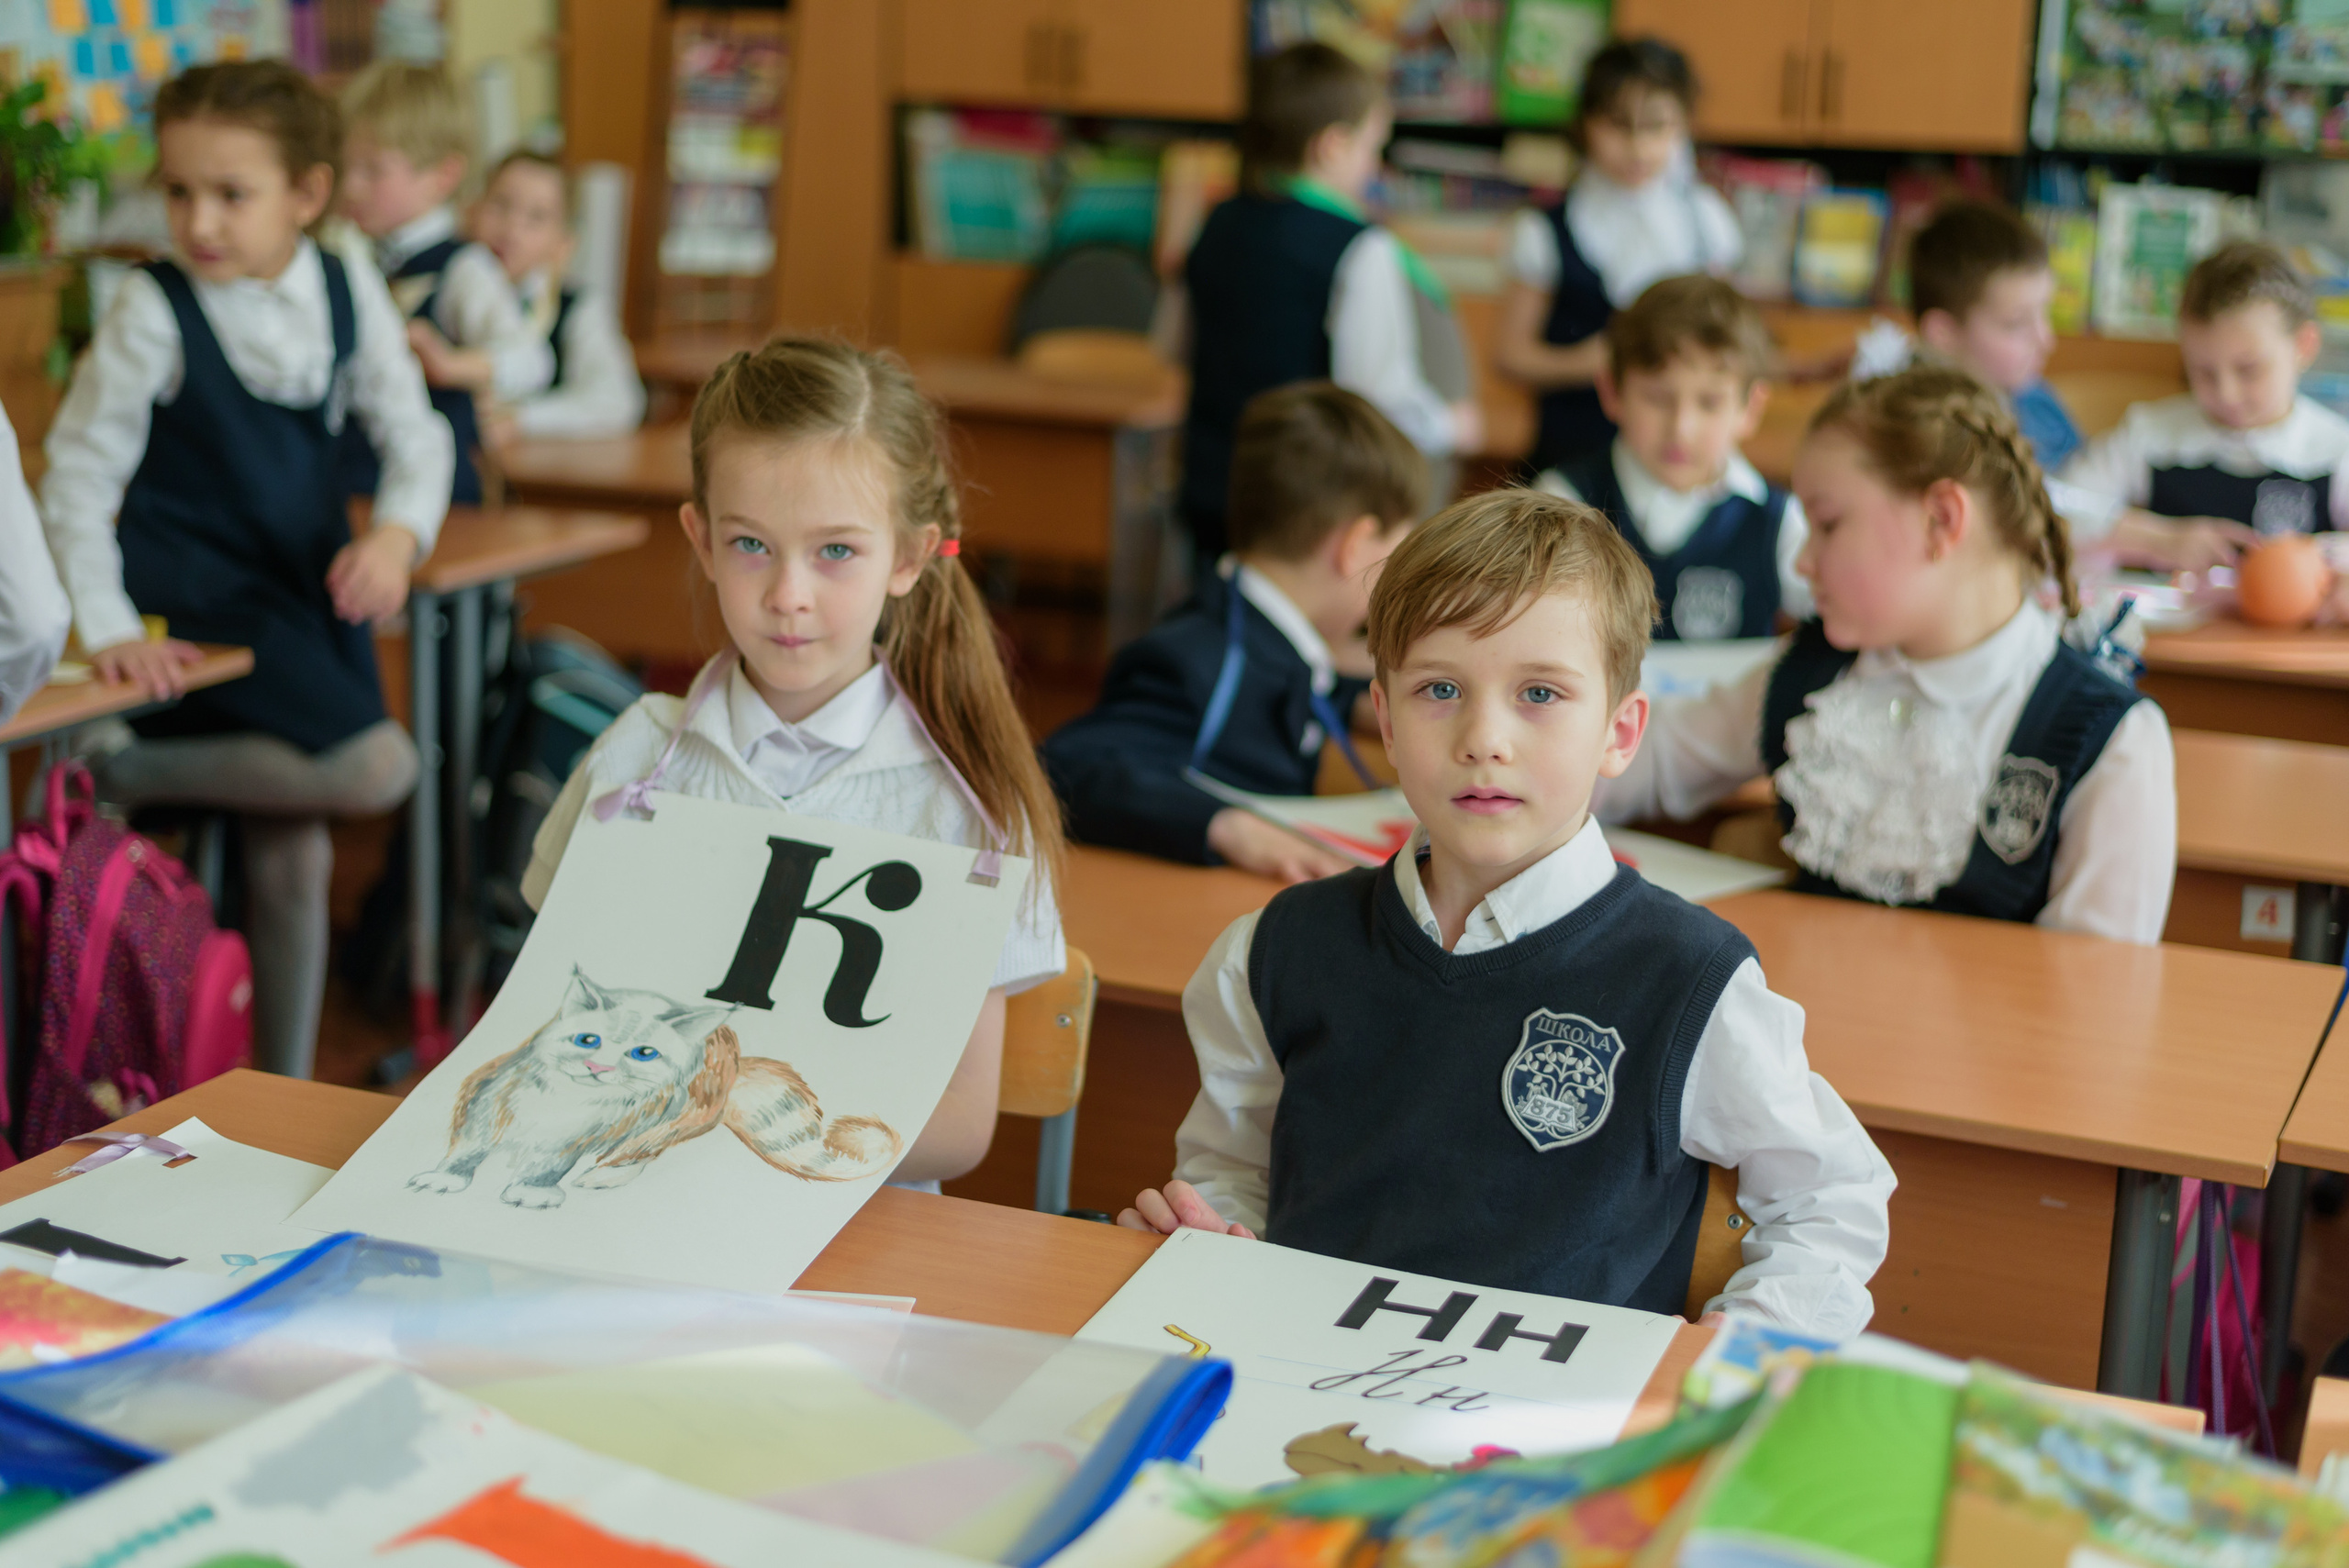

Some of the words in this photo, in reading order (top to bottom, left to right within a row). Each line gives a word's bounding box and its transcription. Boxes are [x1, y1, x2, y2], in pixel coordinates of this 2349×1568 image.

[2256, 895, 2278, 927] 4
[704, 835, 922, 1029] К
[1535, 1016, 1612, 1053] ШКОЛА
[1531, 1099, 1570, 1124] 875
